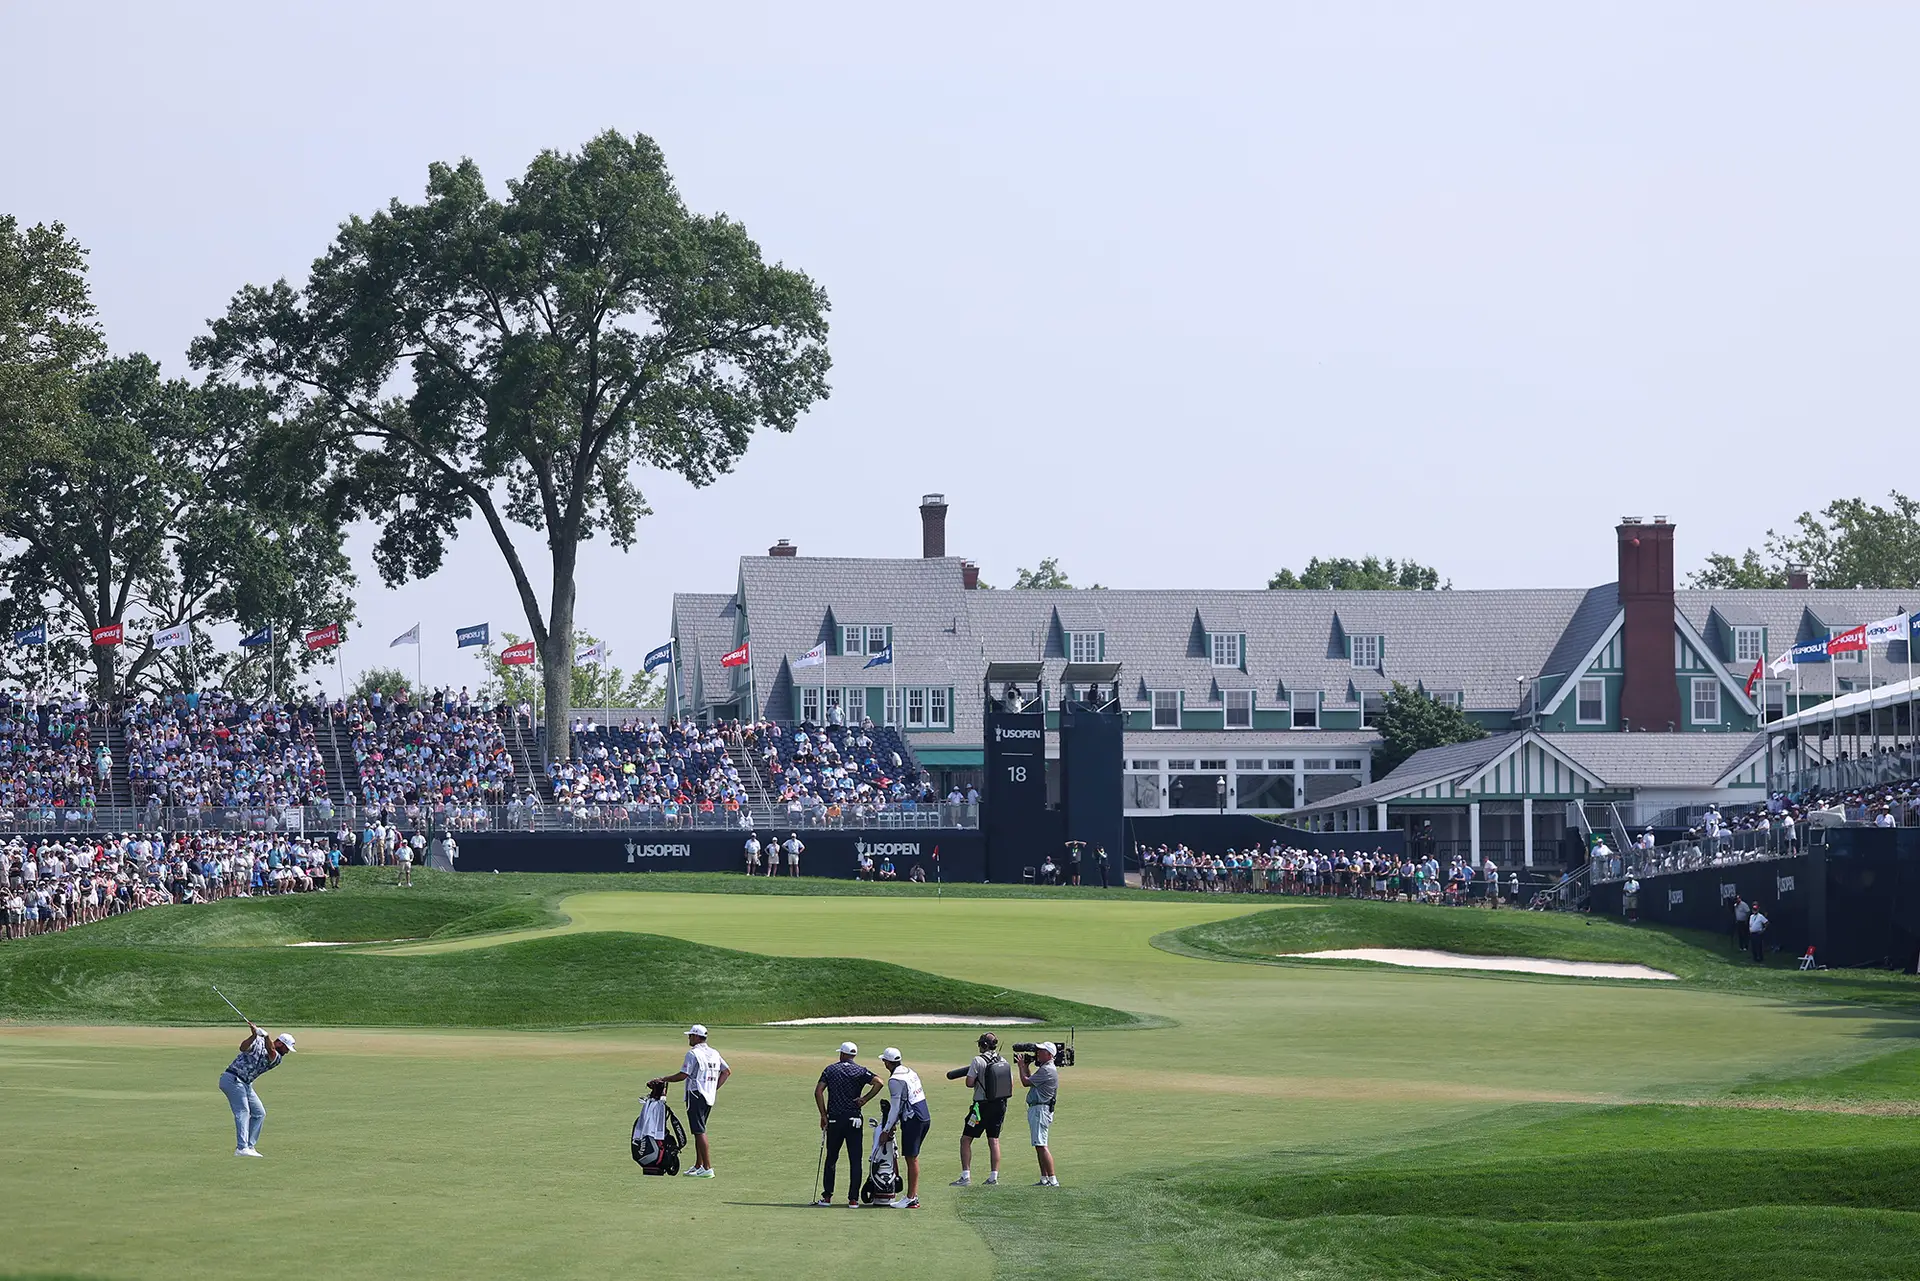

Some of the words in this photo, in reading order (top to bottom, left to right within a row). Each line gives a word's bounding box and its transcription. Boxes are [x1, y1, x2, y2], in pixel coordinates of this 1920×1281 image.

[1002, 729, 1040, 739] USOPEN
[1007, 766, 1027, 782] 18
[636, 844, 690, 857] USOPEN
[867, 843, 920, 856] USOPEN
